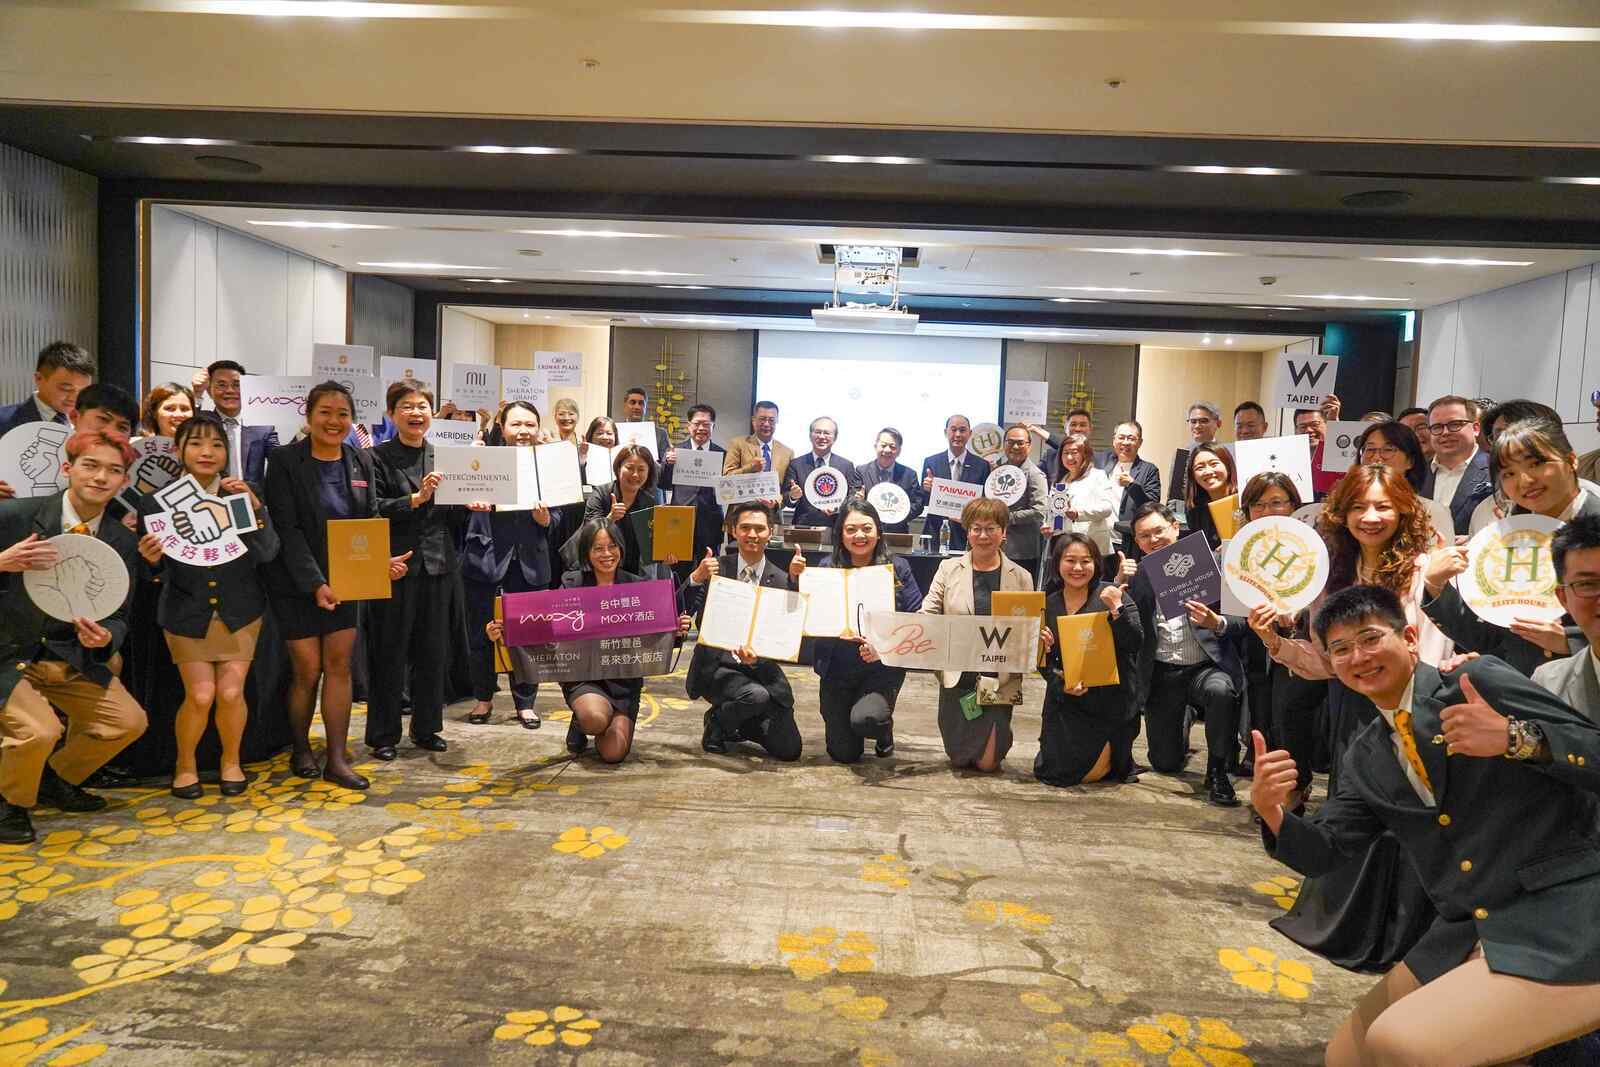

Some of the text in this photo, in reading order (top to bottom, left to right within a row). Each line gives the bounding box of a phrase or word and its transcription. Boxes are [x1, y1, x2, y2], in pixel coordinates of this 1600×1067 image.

[1287, 360, 1328, 388] W
[1286, 393, 1319, 405] TAIPEI
[937, 485, 976, 497] TAIWAN
[150, 519, 240, 561] 合作好夥伴
[1258, 540, 1300, 579] H
[1504, 546, 1541, 582] H
[600, 596, 641, 610] 台中豐邑
[1492, 599, 1546, 608] ELITE HOUSE
[600, 610, 656, 625] MOXY酒店
[600, 636, 641, 649] 新竹豐邑
[880, 623, 936, 656] Be
[979, 626, 1012, 649] W
[528, 653, 581, 664] SHERATON
[600, 651, 665, 666] 喜來登大飯店
[981, 654, 1007, 663] TAIPEI
